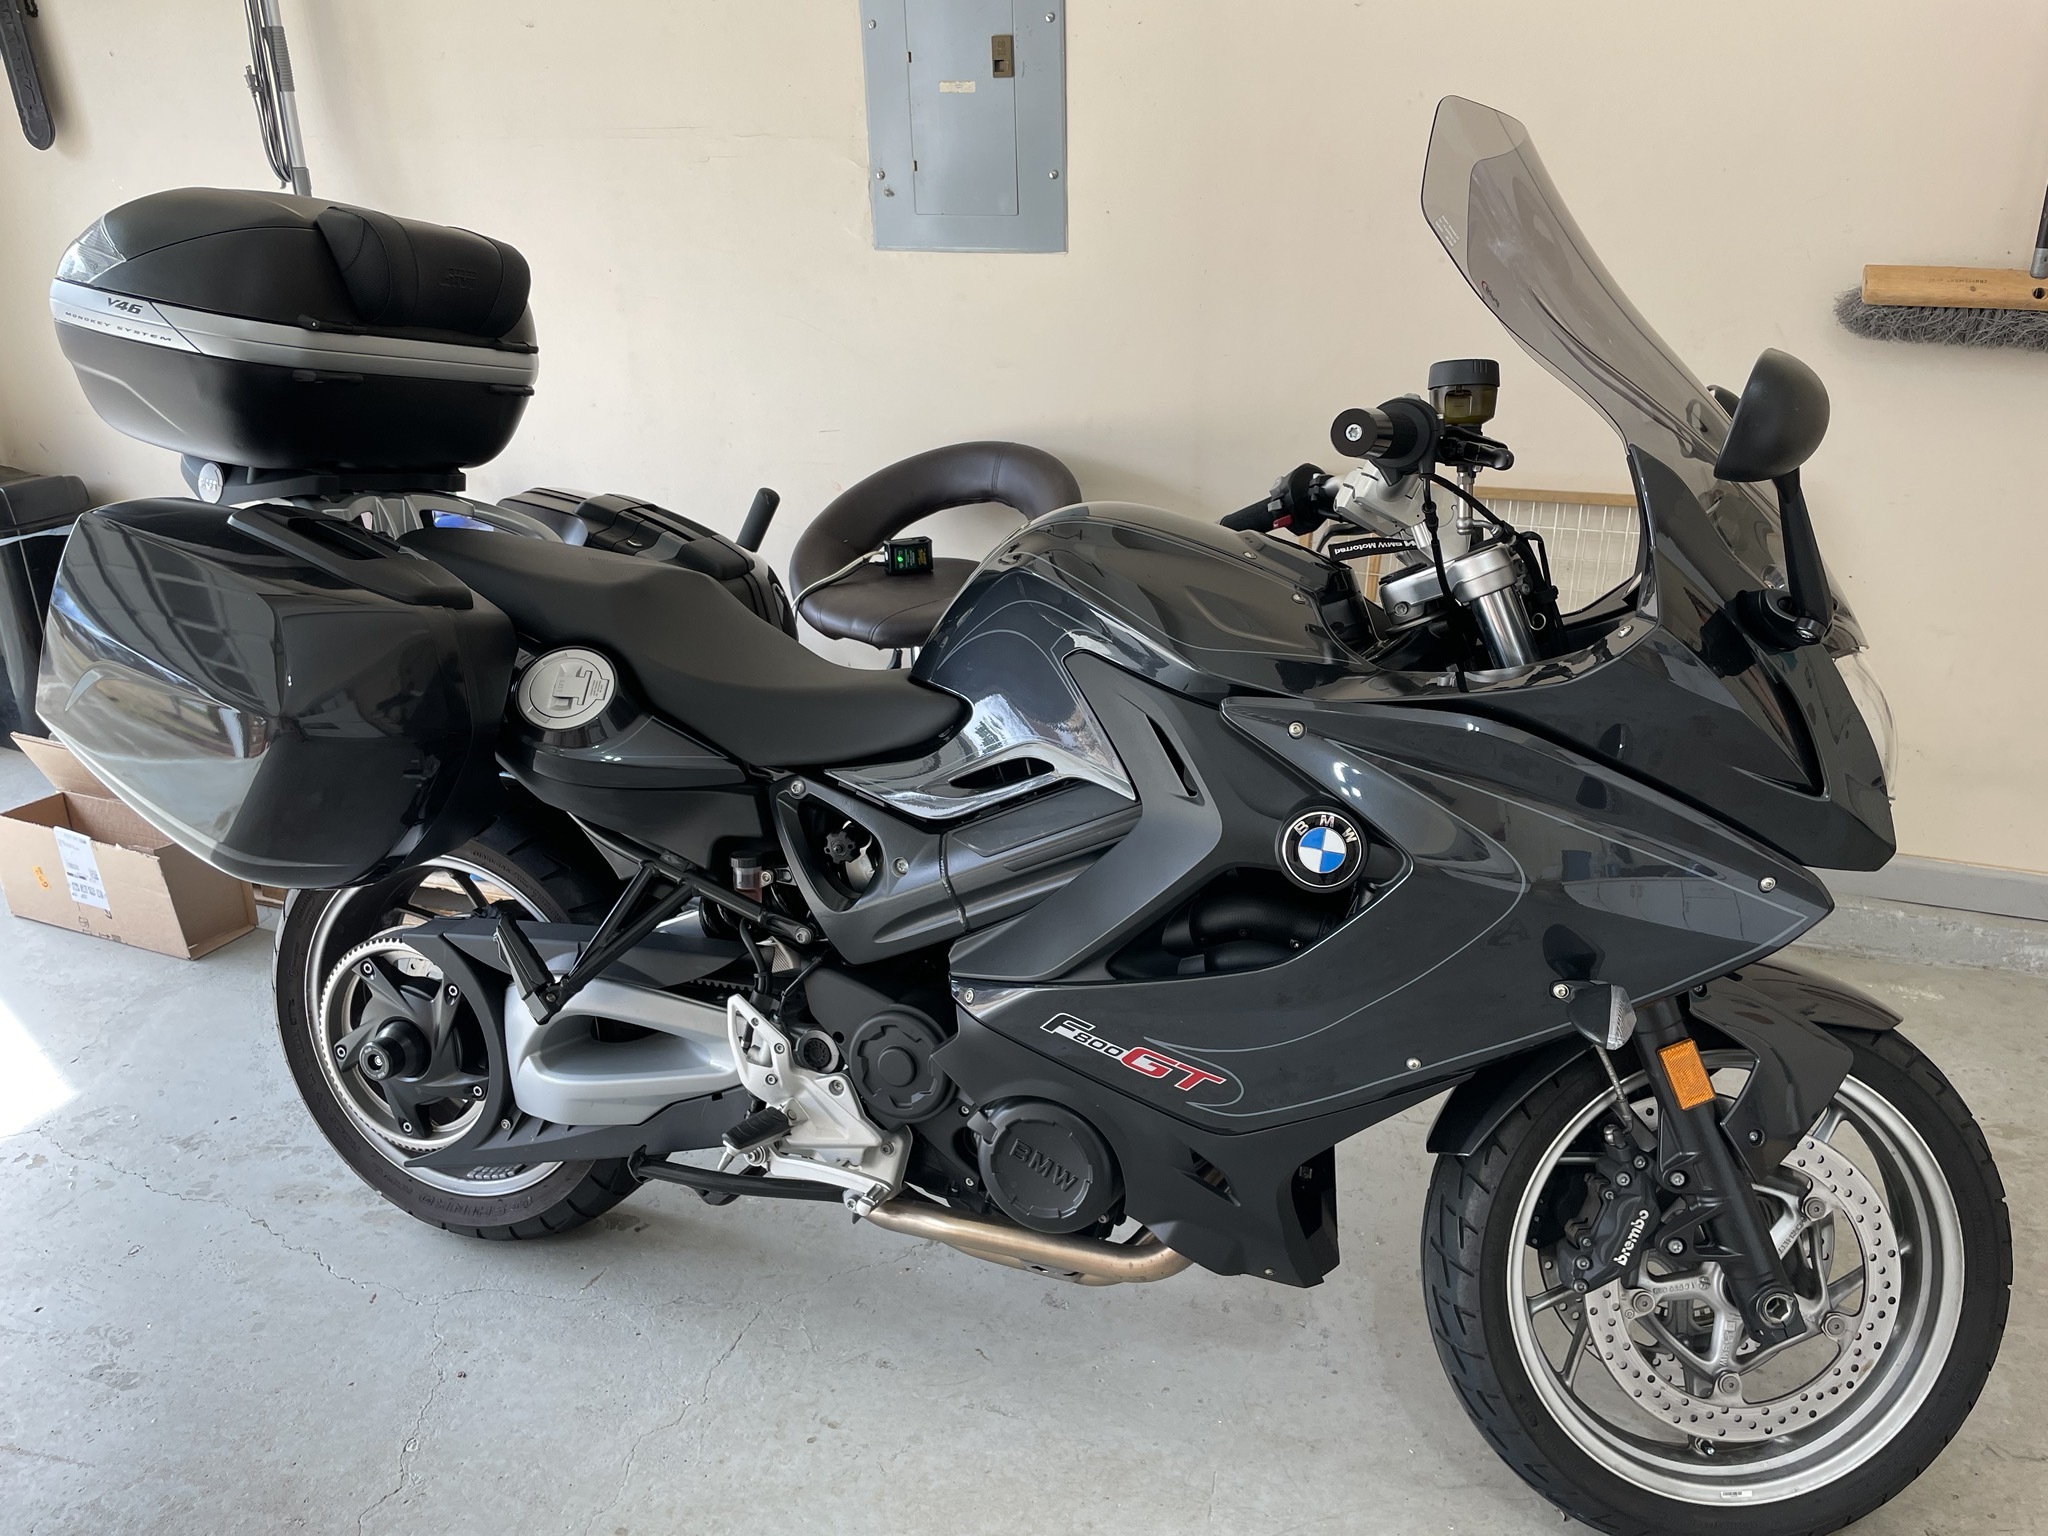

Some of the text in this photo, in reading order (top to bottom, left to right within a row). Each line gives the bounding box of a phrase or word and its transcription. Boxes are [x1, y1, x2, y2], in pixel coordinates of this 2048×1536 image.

[107, 297, 143, 315] V46
[65, 311, 172, 342] MONOKEY SYSTEM
[1334, 542, 1377, 555] Motorrad
[1293, 814, 1358, 844] BMW
[1009, 1138, 1079, 1192] BMW
[1613, 1209, 1650, 1267] brembo
